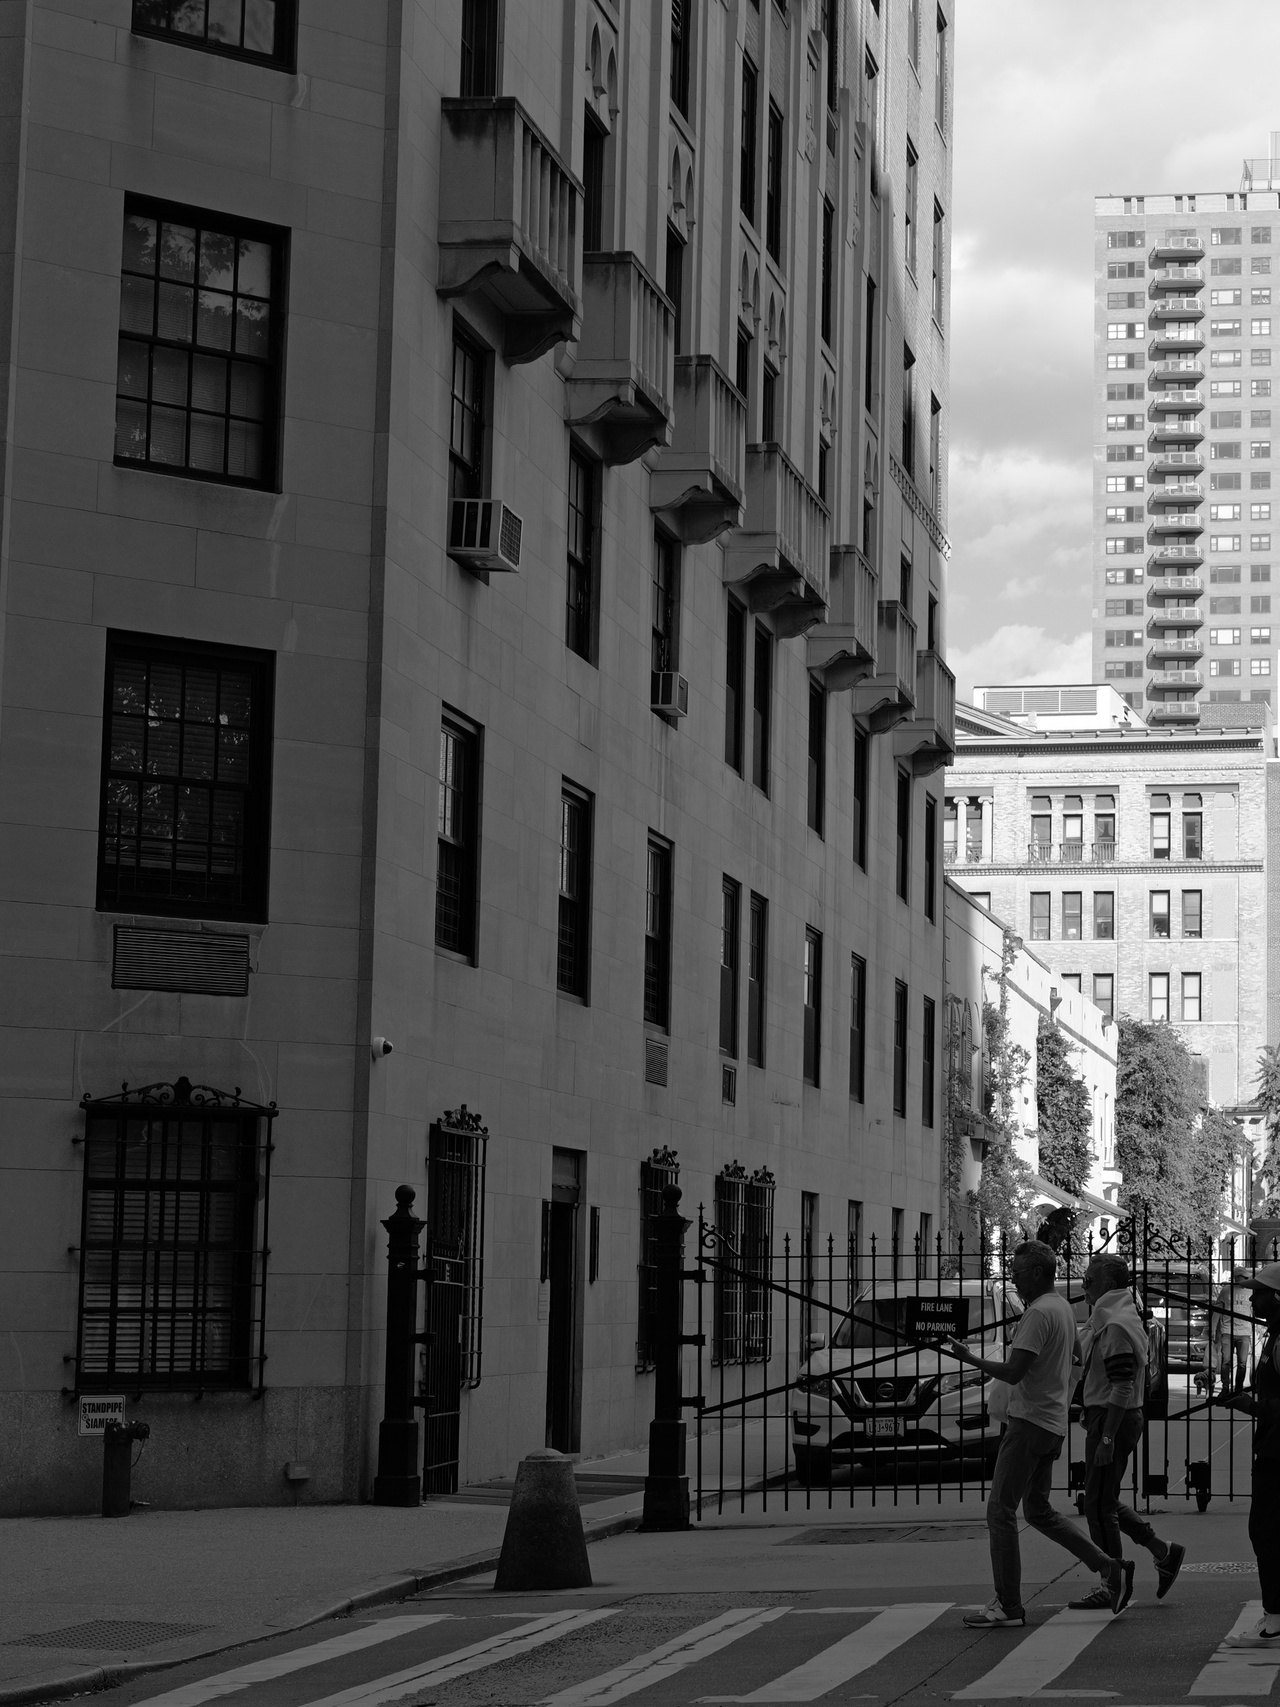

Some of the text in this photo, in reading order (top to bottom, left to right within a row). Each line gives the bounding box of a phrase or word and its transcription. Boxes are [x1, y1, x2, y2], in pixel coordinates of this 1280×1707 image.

[920, 1302, 953, 1313] FIRE LANE
[915, 1321, 956, 1333] NO PARKING
[82, 1402, 123, 1414] STANDPIPE
